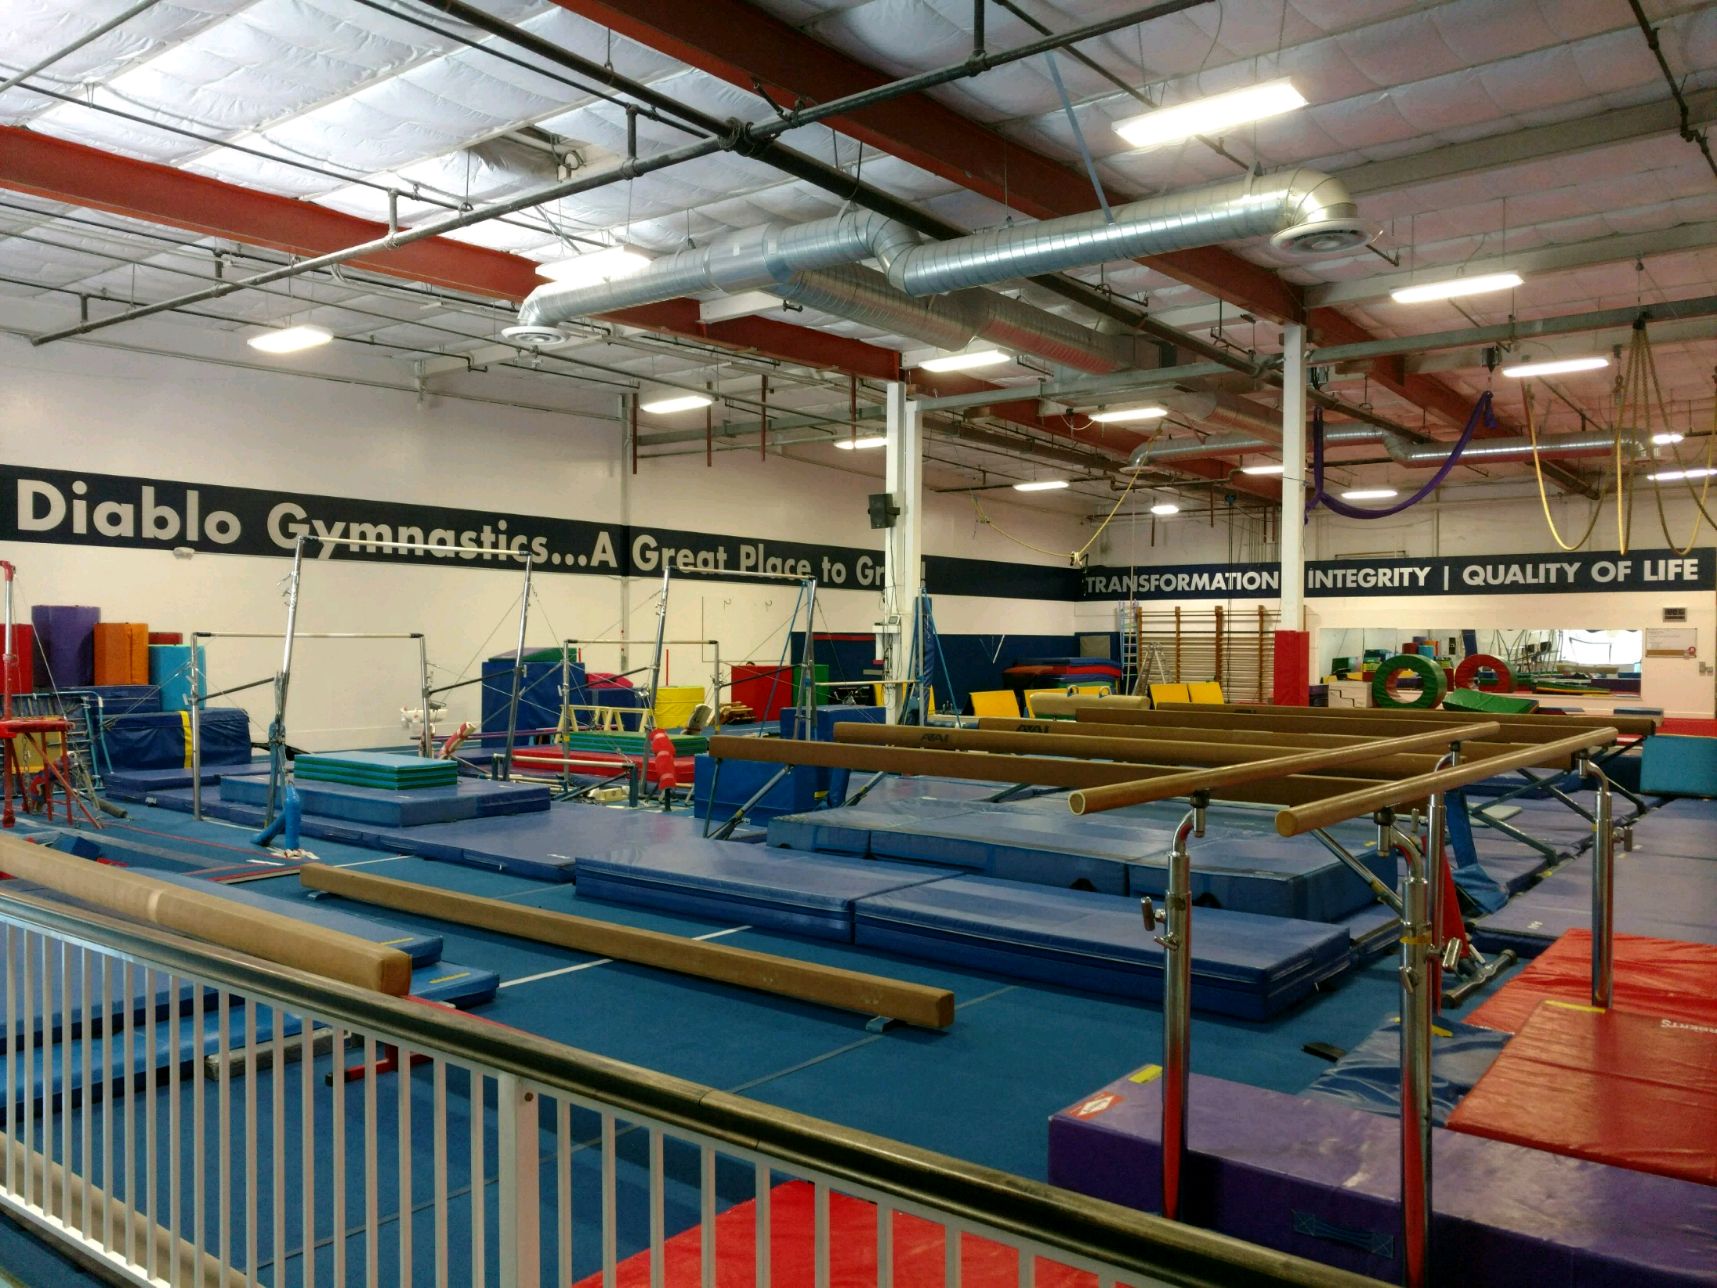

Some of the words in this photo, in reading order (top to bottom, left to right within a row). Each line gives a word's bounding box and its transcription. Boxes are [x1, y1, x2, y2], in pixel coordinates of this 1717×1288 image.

[17, 478, 242, 544] Diablo
[632, 535, 728, 574] Great
[740, 543, 812, 580] Place
[822, 556, 847, 584] to
[1086, 571, 1279, 594] TRANSFORMATION
[1308, 567, 1432, 589] INTEGRITY
[1462, 562, 1582, 586] QUALITY
[1591, 560, 1632, 583] OF
[1643, 558, 1699, 582] LIFE
